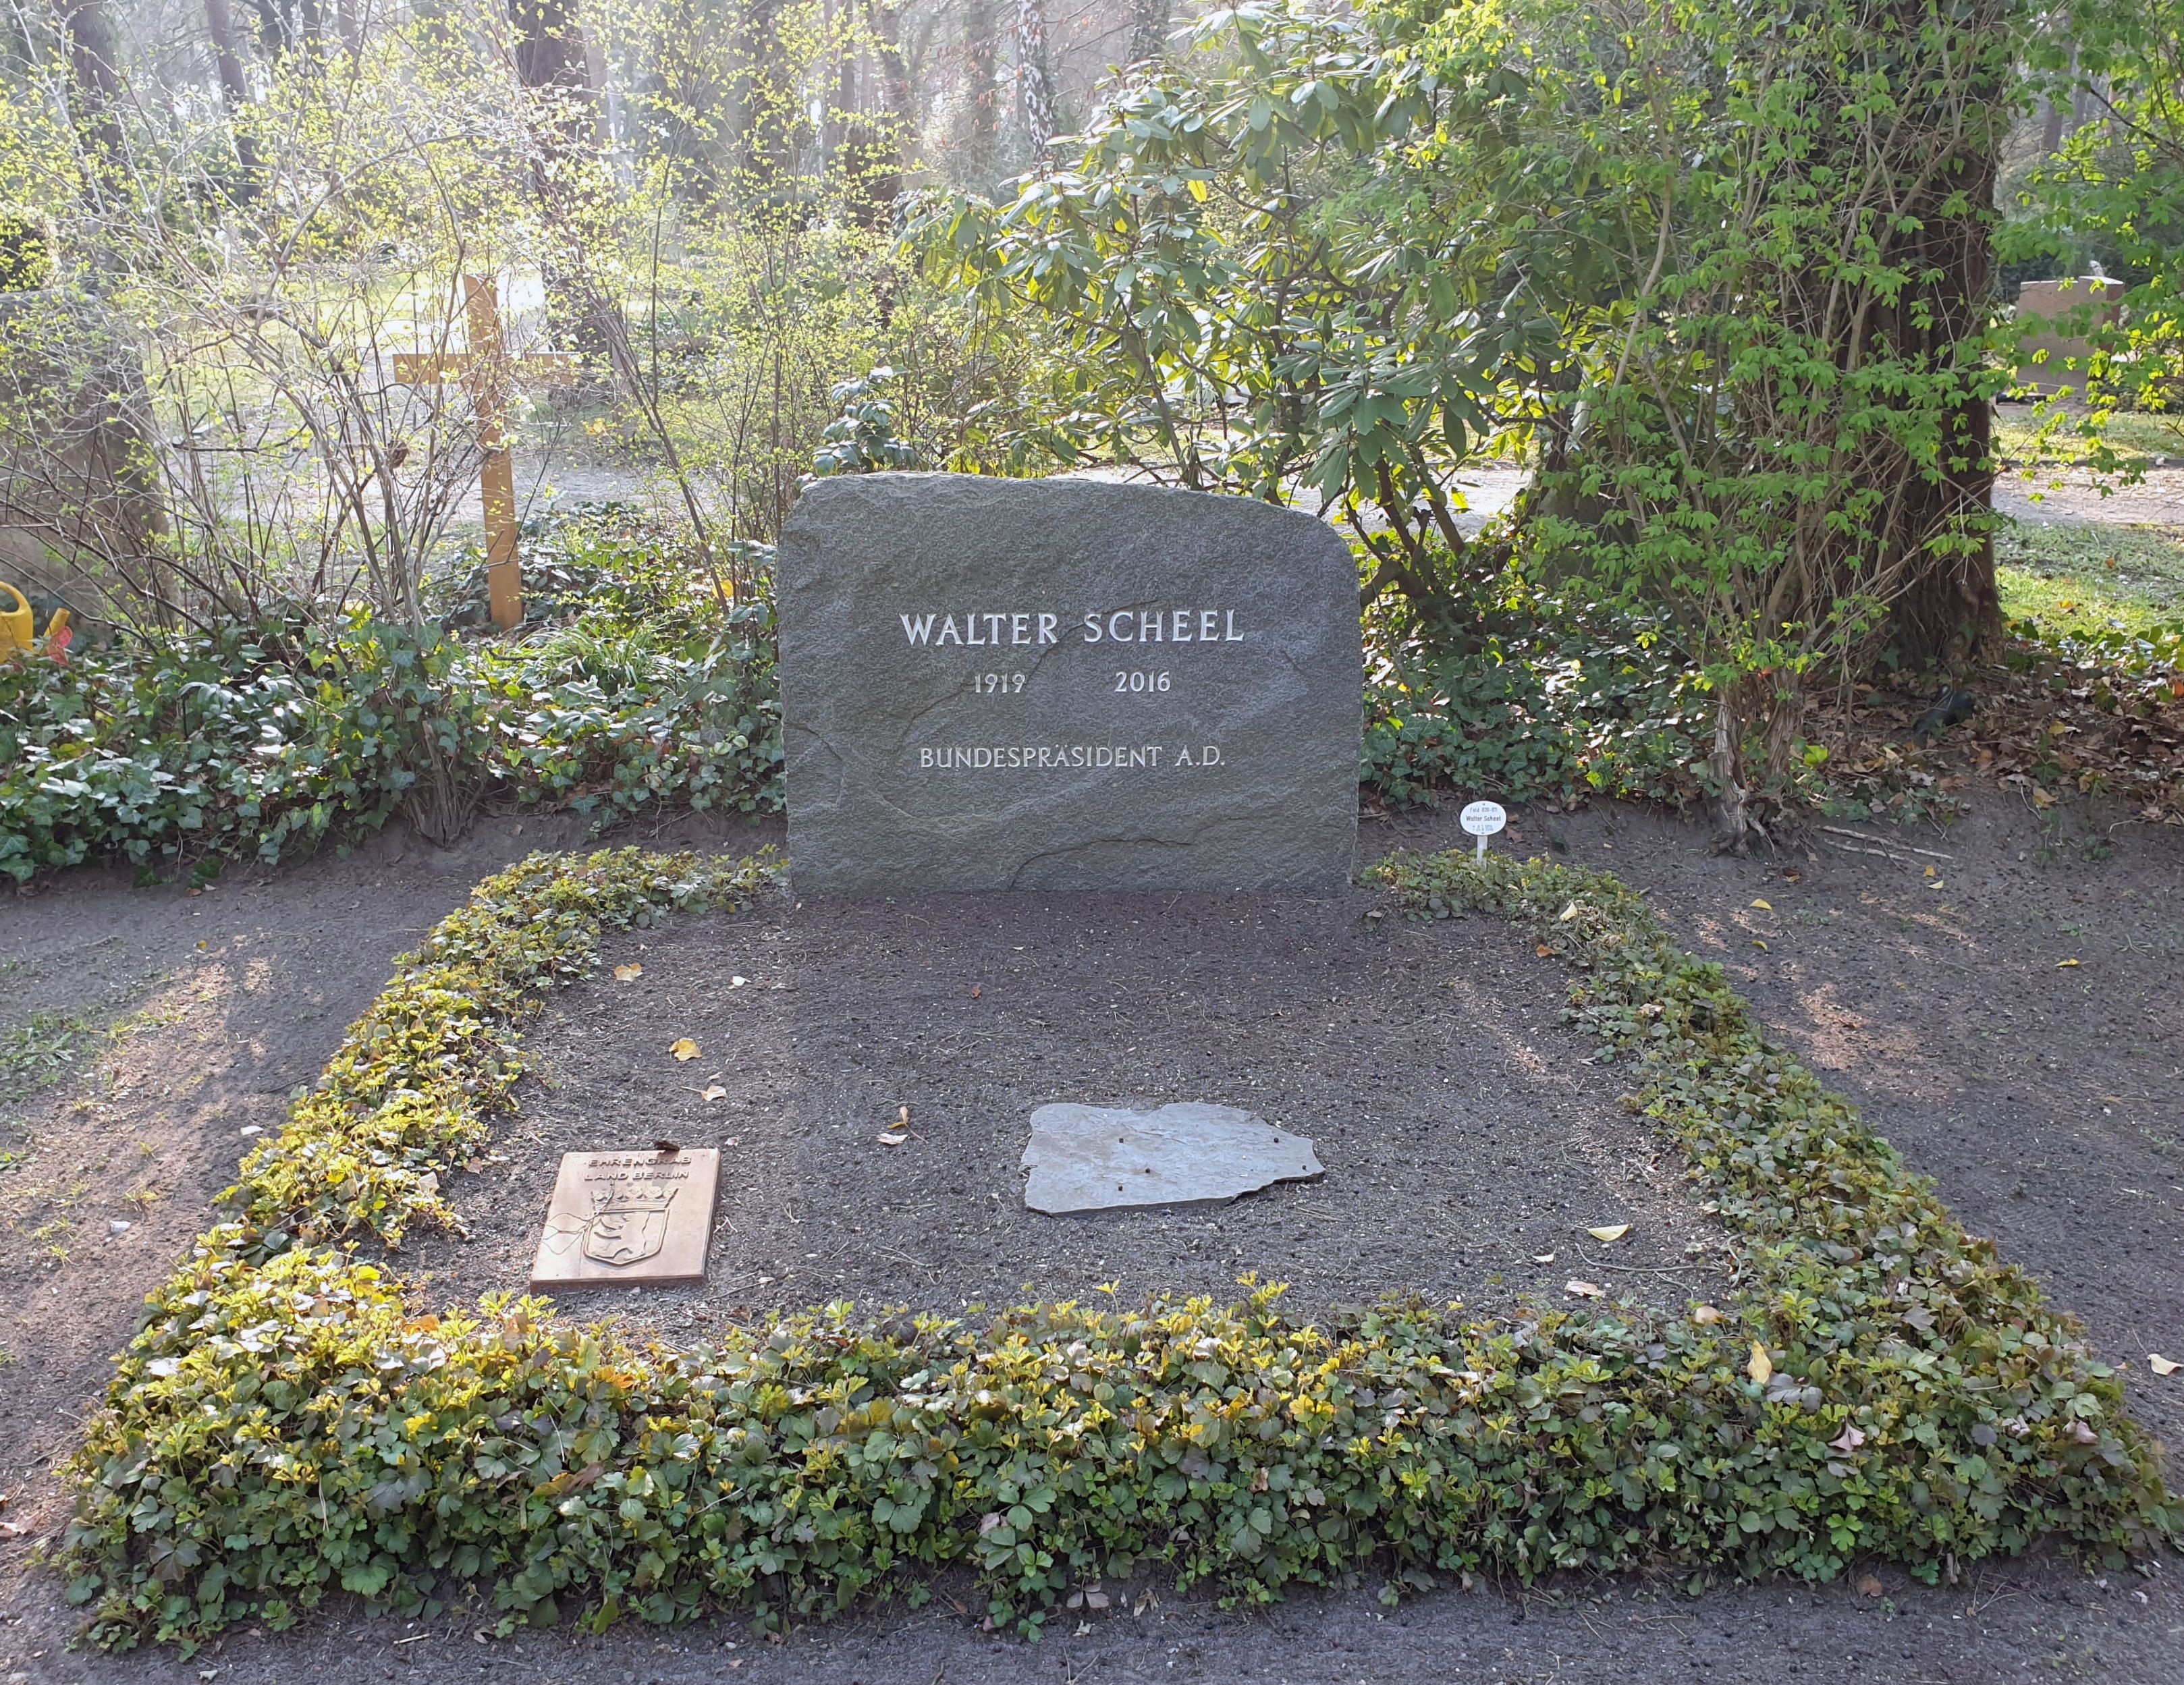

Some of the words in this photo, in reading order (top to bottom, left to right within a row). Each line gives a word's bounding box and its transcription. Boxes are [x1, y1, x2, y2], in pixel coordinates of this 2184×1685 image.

[899, 612, 1060, 646] WALTER
[1084, 609, 1245, 643] SCHEEL
[974, 673, 1027, 694] 1919
[1114, 671, 1172, 693] 2016
[920, 744, 1162, 768] BUNDESPRÄSIDENT
[1174, 745, 1226, 767] A.D.
[588, 1156, 692, 1168] EHRENGRAB
[584, 1171, 628, 1182] LAND
[632, 1170, 689, 1181] BERLIN
